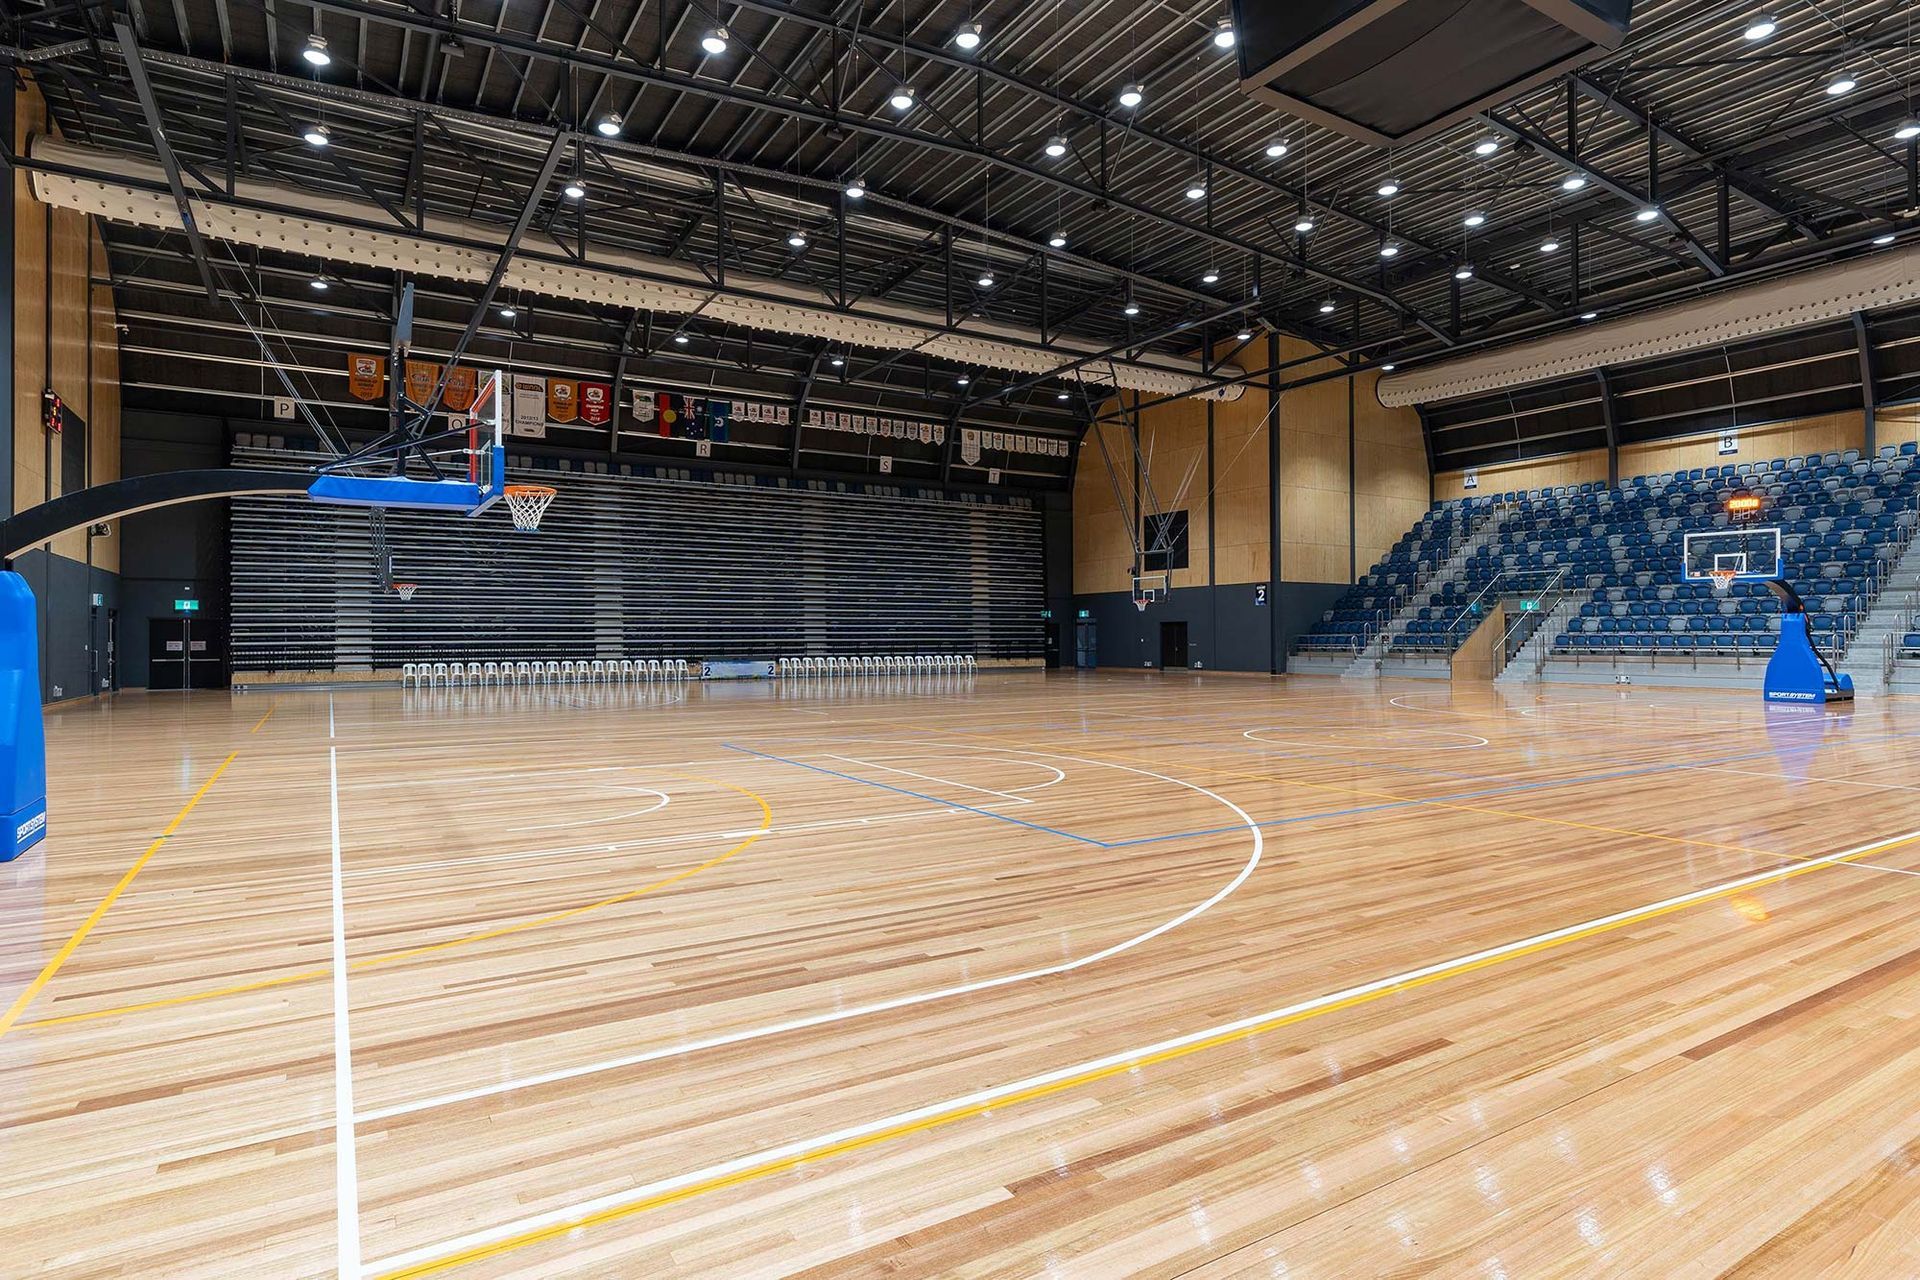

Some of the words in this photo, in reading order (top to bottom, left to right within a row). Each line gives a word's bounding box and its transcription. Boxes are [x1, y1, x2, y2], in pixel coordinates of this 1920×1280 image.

[280, 402, 289, 415] P
[1724, 436, 1733, 449] B
[700, 443, 707, 455] R
[883, 460, 889, 471] S
[1467, 474, 1475, 484] A
[1258, 589, 1265, 601] 2
[704, 666, 711, 676] 2
[768, 665, 775, 675] 2
